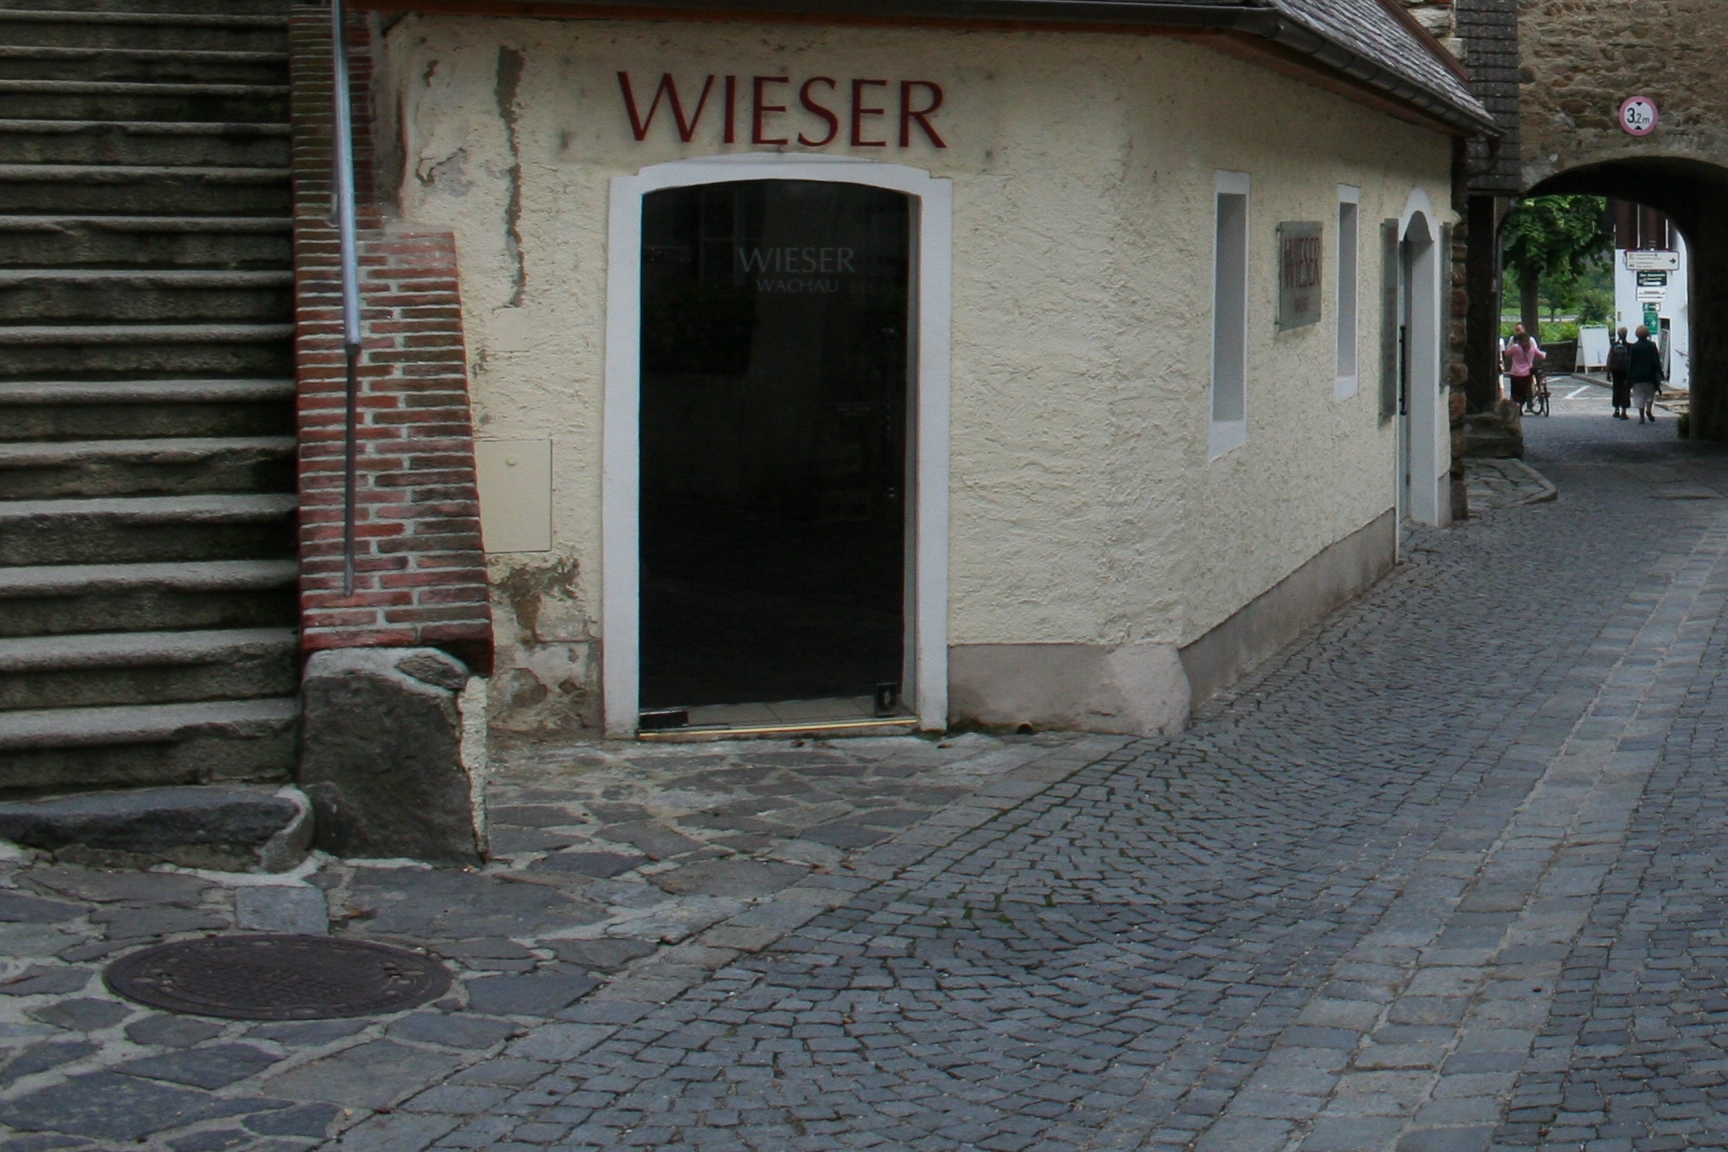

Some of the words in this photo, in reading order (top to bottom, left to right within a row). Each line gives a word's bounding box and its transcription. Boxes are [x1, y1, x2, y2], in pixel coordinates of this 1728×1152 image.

[616, 70, 948, 148] WIESER
[738, 247, 856, 273] WIESER
[1284, 236, 1321, 290] WIESER
[756, 278, 839, 293] WACHAU
